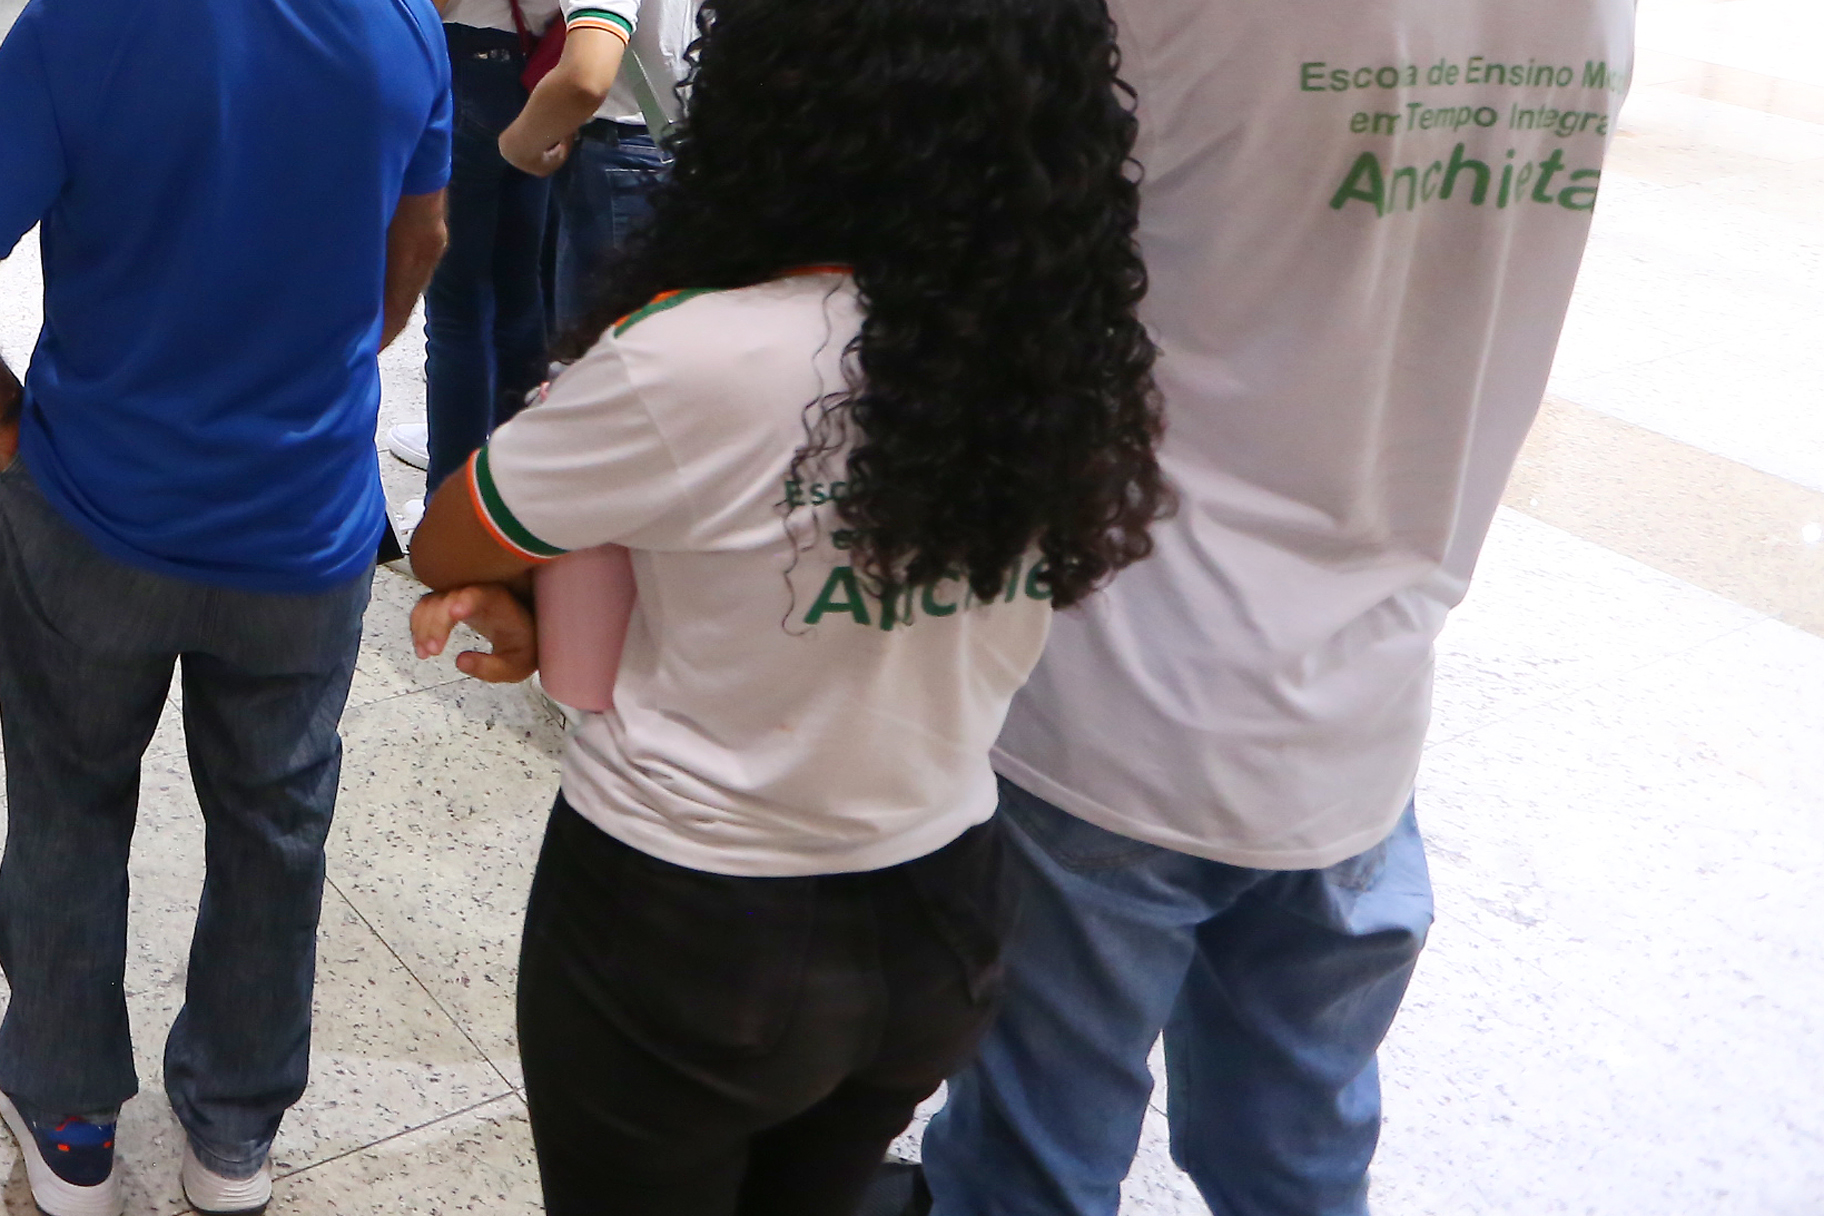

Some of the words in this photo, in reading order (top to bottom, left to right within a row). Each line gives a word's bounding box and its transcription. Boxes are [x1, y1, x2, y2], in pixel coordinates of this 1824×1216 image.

[1426, 57, 1459, 87] de
[1465, 56, 1574, 89] Ensino
[1406, 101, 1498, 134] Tempo
[1508, 102, 1609, 138] Integra
